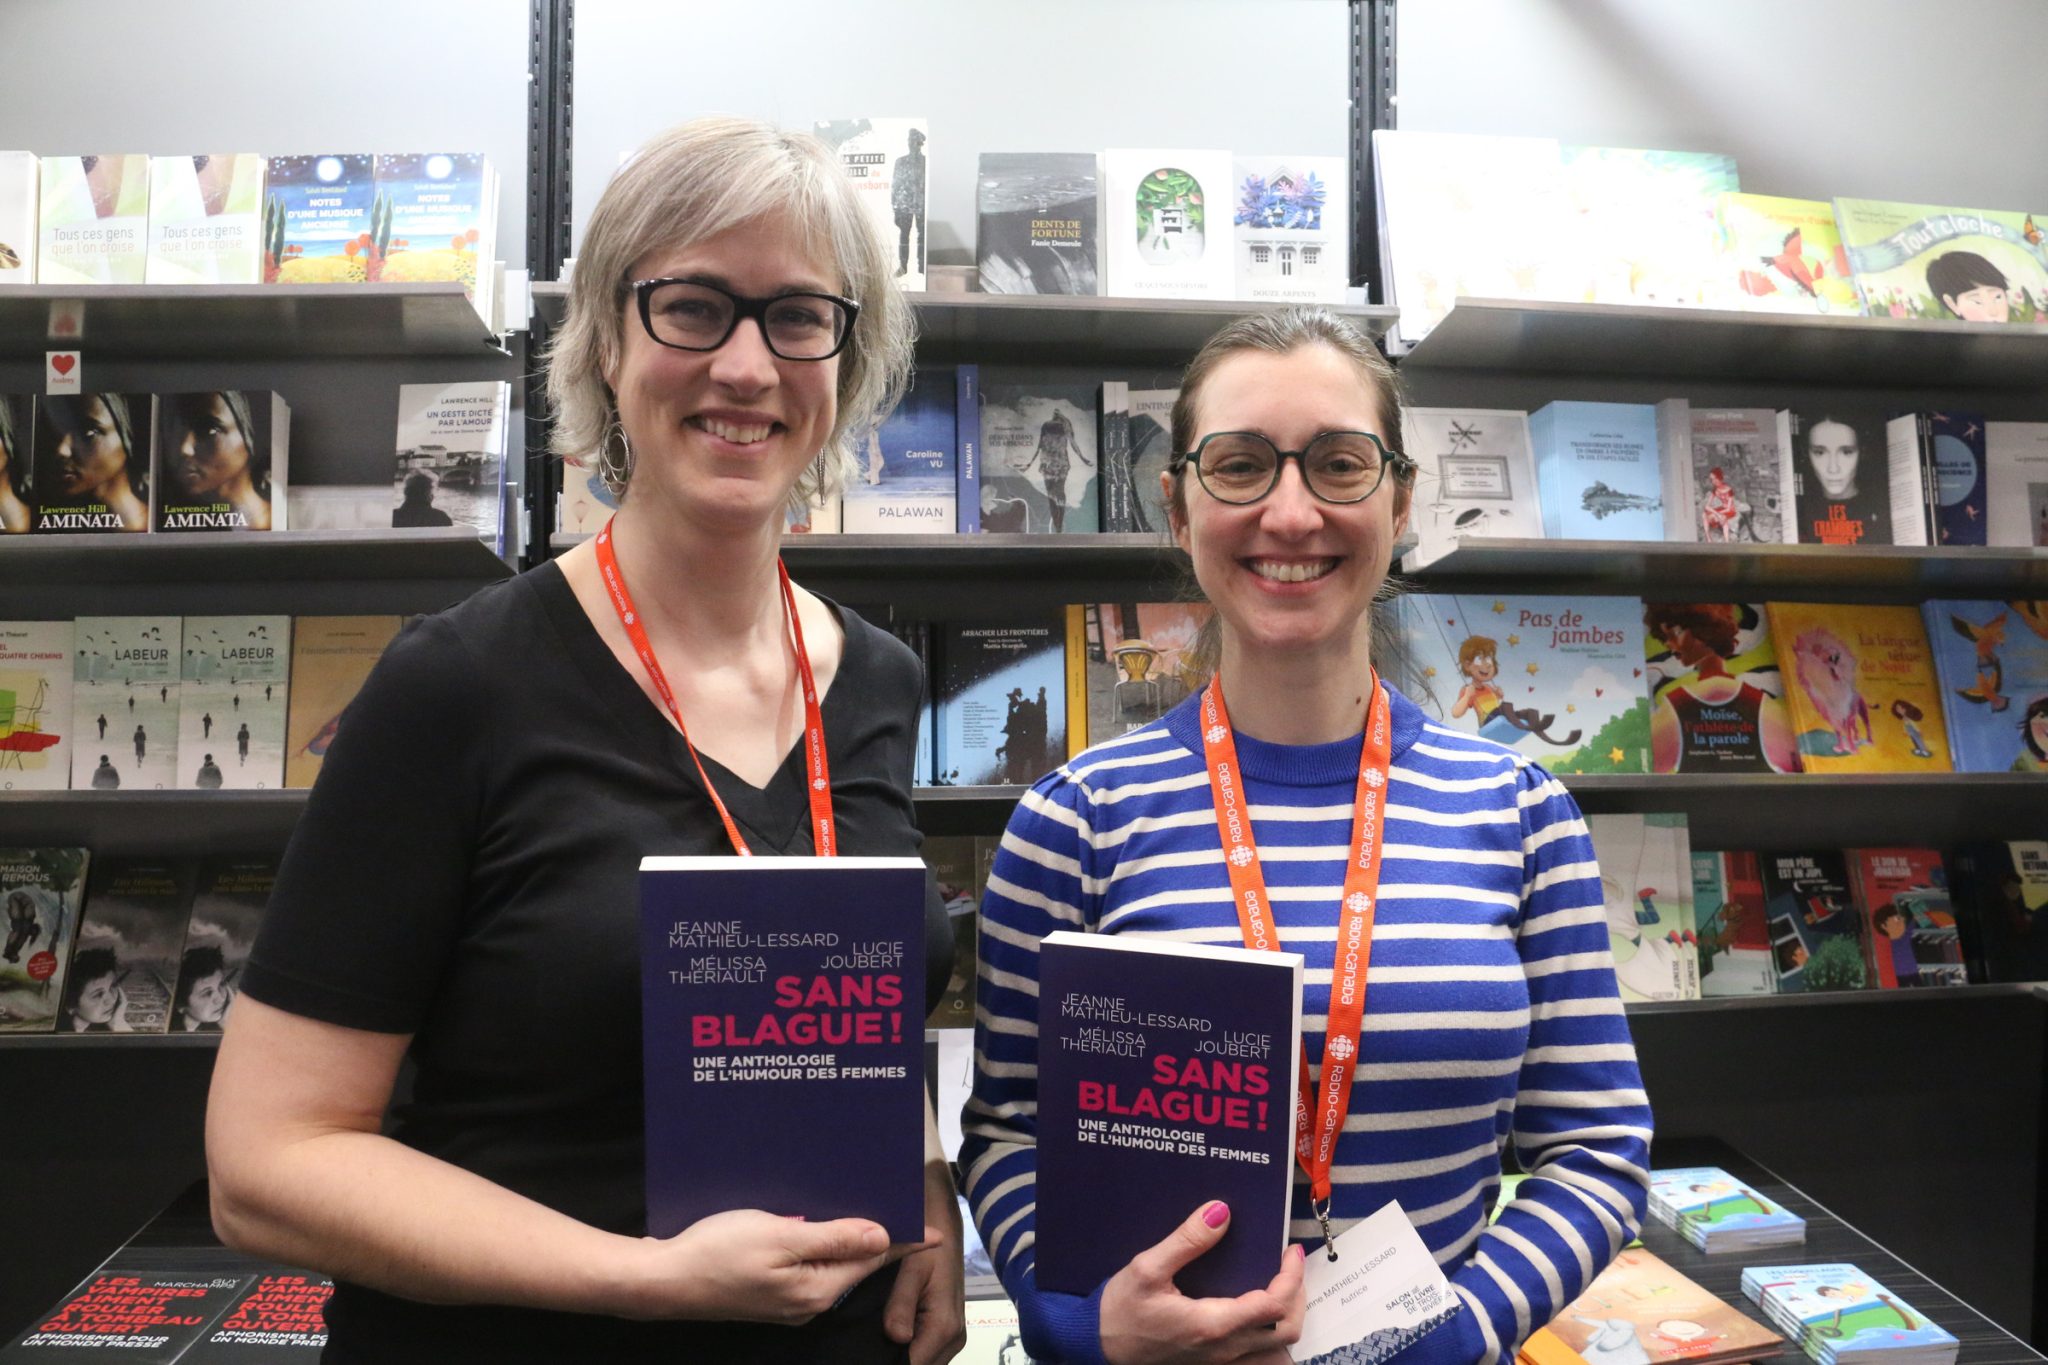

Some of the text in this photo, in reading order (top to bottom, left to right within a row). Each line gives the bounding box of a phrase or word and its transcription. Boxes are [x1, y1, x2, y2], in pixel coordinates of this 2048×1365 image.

[309, 198, 342, 208] NOTES
[417, 194, 451, 204] NOTES
[287, 208, 364, 219] D'UNE MUSIQUE
[427, 204, 472, 213] MUSIQUE
[1031, 219, 1081, 229] DENTS DE
[53, 227, 135, 242] Tous ces gens
[162, 225, 243, 240] Tous ces gens
[1031, 229, 1082, 238] FORTUNE
[1892, 216, 1942, 256] Tout
[1939, 212, 2004, 239] cloche
[52, 240, 134, 257] que l'on croise
[160, 237, 243, 254] que l'on croise
[1031, 239, 1051, 247] Fanie
[1253, 290, 1317, 298] DOUZE ARPENTS
[441, 397, 477, 405] LAWRENCE
[427, 411, 439, 419] UN
[440, 410, 467, 418] GESTE
[457, 418, 492, 426] L'AMOUR
[905, 450, 944, 459] Caroline
[929, 460, 944, 469] VU
[965, 443, 974, 480] PALAWAN
[39, 504, 107, 514] Lawrence Hill
[164, 503, 231, 514] Lawrence Hill
[878, 507, 944, 518] PALAWAN
[1828, 504, 1847, 521] LES
[39, 513, 125, 530] AMINATA
[164, 512, 249, 529] AMINATA
[1518, 608, 1584, 628] Pas de
[961, 627, 1049, 638] ARRACHER LES FRONTIÈRES
[1549, 626, 1625, 649] jambes
[30, 652, 64, 660] CHEMINS
[114, 648, 169, 661] LABEUR
[222, 647, 274, 660] LABEUR
[1700, 708, 1743, 721] Moïse,
[1740, 722, 1756, 734] de
[1693, 732, 1750, 748] la parole
[0, 864, 41, 874] MAISON
[2, 873, 50, 882] REMOUS
[669, 920, 742, 936] JEANNE
[669, 933, 839, 949] MATHIEU-LESSARD
[852, 941, 904, 956] LUCIE
[690, 954, 767, 971] MÉLISSA
[820, 954, 904, 970] JOUBERT
[668, 969, 767, 985] THÉRIAULT
[774, 974, 904, 1009] SANS
[1061, 992, 1126, 1012] JEANNE
[1061, 1004, 1213, 1033] MATHIEU-LESSARD
[1079, 1025, 1147, 1046] MÉLISSA
[1223, 1030, 1272, 1047] LUCIE
[1059, 1036, 1147, 1058] THÉRIAULT
[1194, 1040, 1272, 1060] JOUBERT
[693, 1054, 836, 1069] UNE ANTHOLOGIE
[693, 1066, 907, 1082] DE L'HUMOUR DES FEMMES
[1151, 1053, 1270, 1096] SANS
[1077, 1118, 1206, 1144] UNE ANTHOLOGIE
[1077, 1130, 1271, 1165] DE L'HUMOUR DES FEMMES
[1322, 1246, 1398, 1299] MATHIEU-LESSARD
[99, 1276, 141, 1287] LES
[153, 1280, 237, 1290] MARCHAMPS
[212, 1277, 241, 1286] GUY
[262, 1275, 306, 1286] LES
[87, 1286, 209, 1298] VAMPIRES
[1340, 1284, 1369, 1307] Autrice
[1402, 1283, 1436, 1309] DU LIVRE
[70, 1294, 176, 1306] AIMENT
[1385, 1291, 1412, 1312] SALON
[62, 1303, 168, 1316] ROULER
[238, 1301, 326, 1313] ROULE
[1406, 1303, 1419, 1315] DE
[51, 1310, 204, 1327] À TOMBEAU
[227, 1310, 250, 1322] À
[38, 1322, 153, 1335] OUVERT
[222, 1319, 329, 1333] OUVERT
[29, 1333, 170, 1344] APHORISMES POUR
[210, 1336, 233, 1345] UN
[235, 1337, 291, 1347] MONDE
[213, 1331, 307, 1342] APHORISMES
[21, 1339, 45, 1347] UN
[46, 1339, 104, 1348] MONDE
